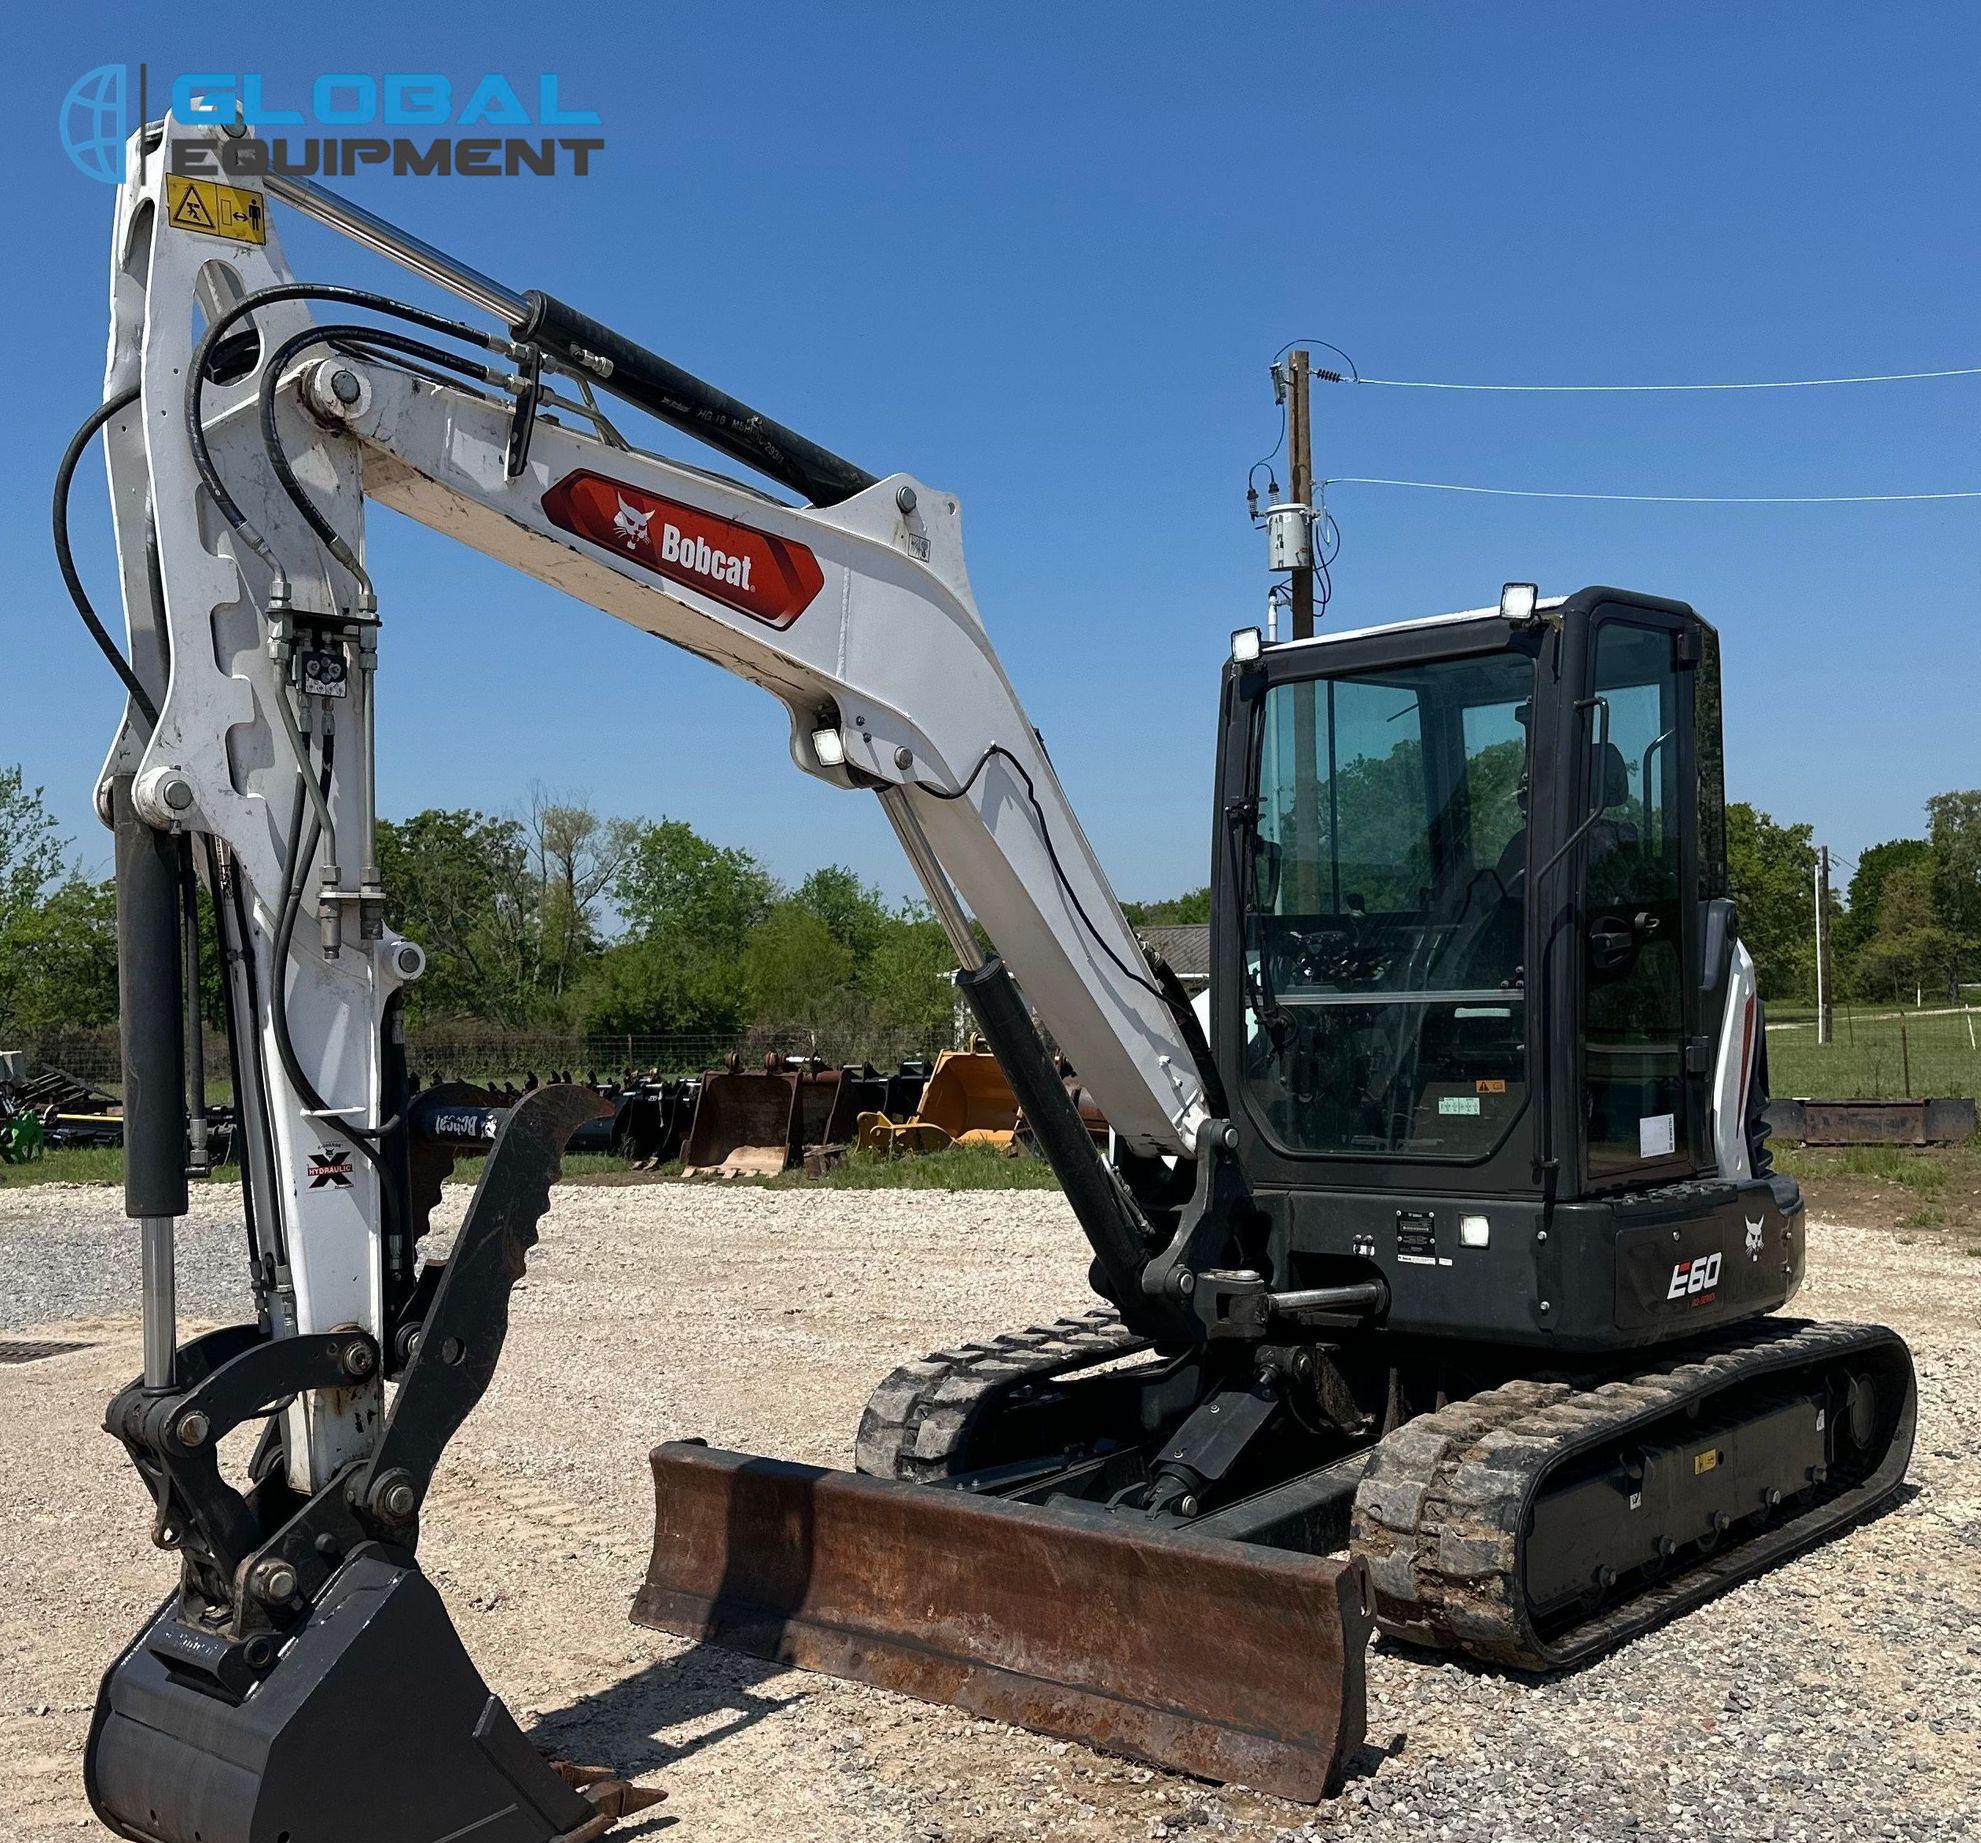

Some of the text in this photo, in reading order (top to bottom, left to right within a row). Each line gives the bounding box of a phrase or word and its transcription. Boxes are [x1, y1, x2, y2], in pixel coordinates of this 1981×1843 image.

[662, 522, 752, 591] Bobcat
[309, 1165, 351, 1175] HYDRAULIC
[1667, 1251, 1722, 1300] E60
